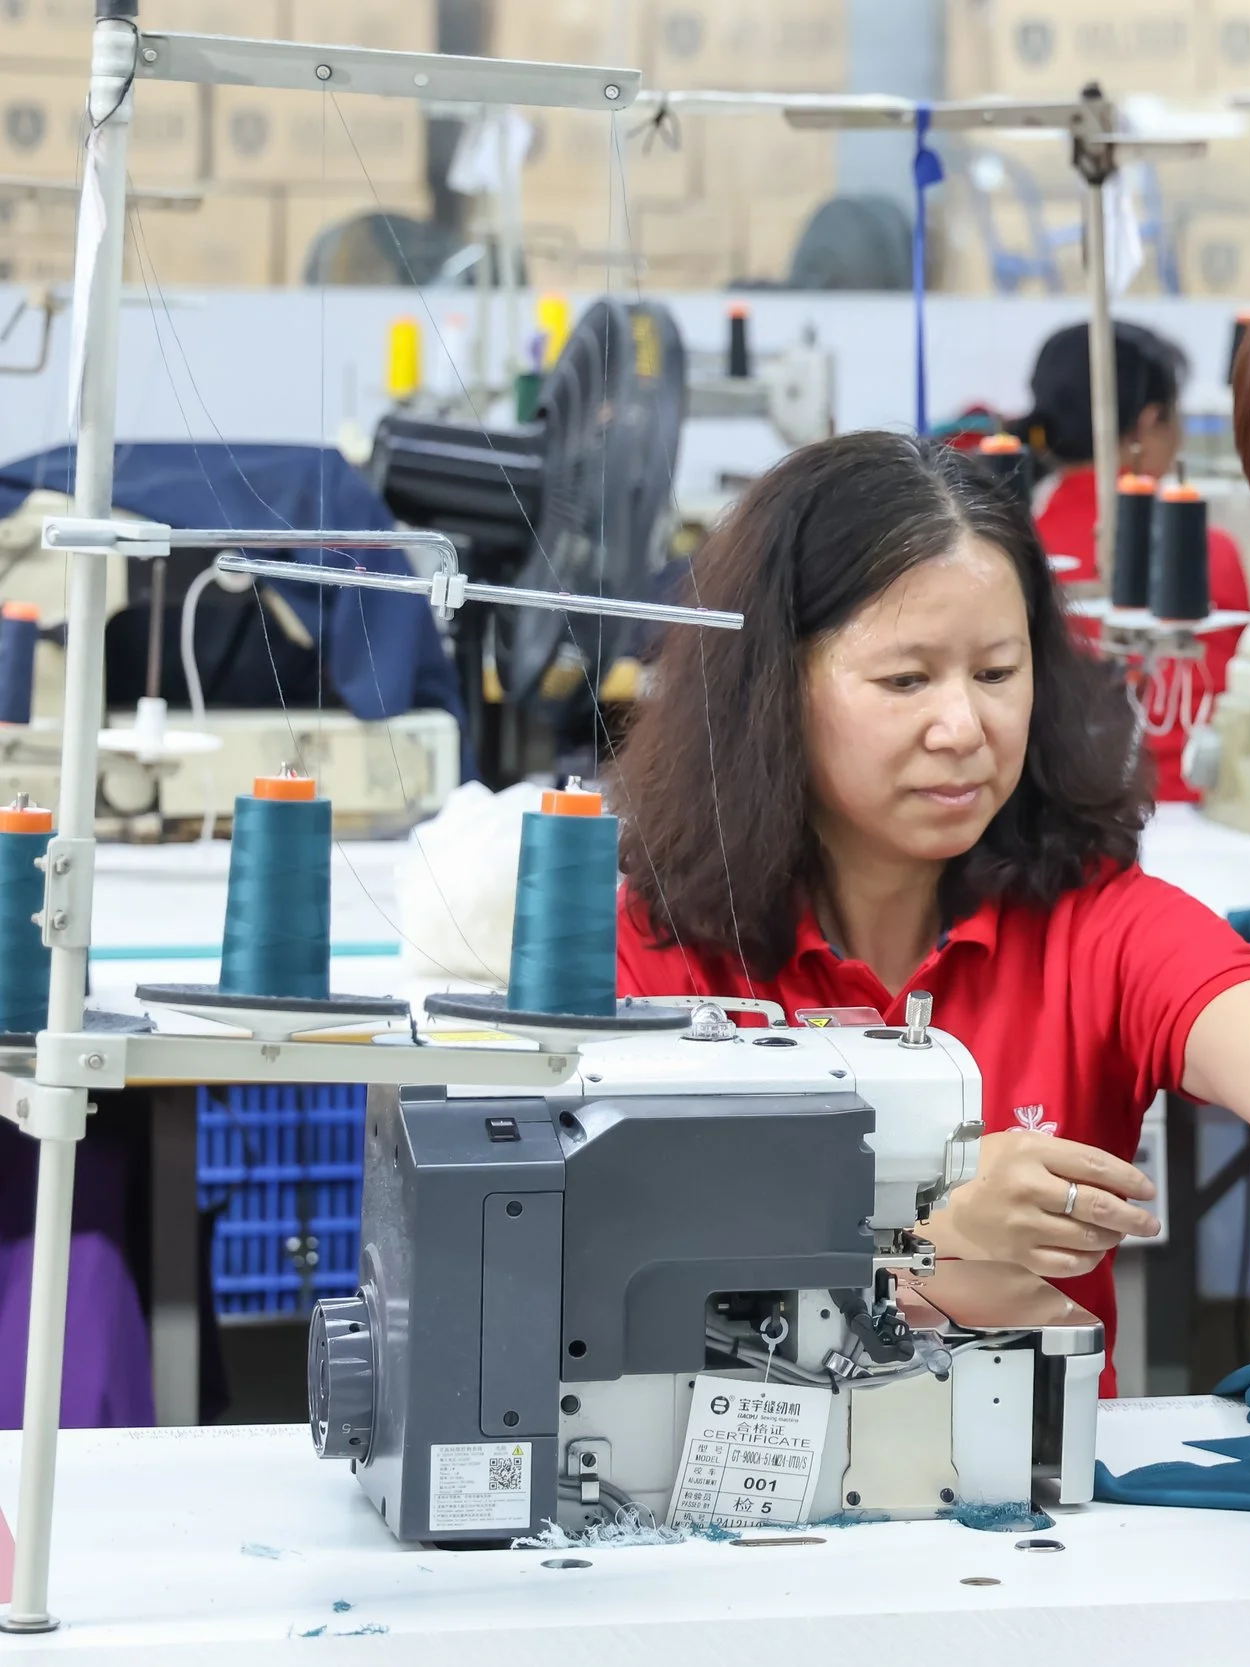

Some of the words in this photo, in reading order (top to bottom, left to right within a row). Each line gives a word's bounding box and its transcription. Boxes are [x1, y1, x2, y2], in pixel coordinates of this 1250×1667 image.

[738, 1398, 801, 1416] 宝宇缝纫机
[737, 1421, 786, 1436] 合格证
[703, 1429, 811, 1449] CERTIFICATE
[695, 1454, 720, 1463] MODEL
[743, 1477, 777, 1492] 001
[684, 1491, 711, 1501] 检验员
[681, 1500, 702, 1509] PASSED
[733, 1496, 754, 1513] 检
[760, 1502, 772, 1514] 5
